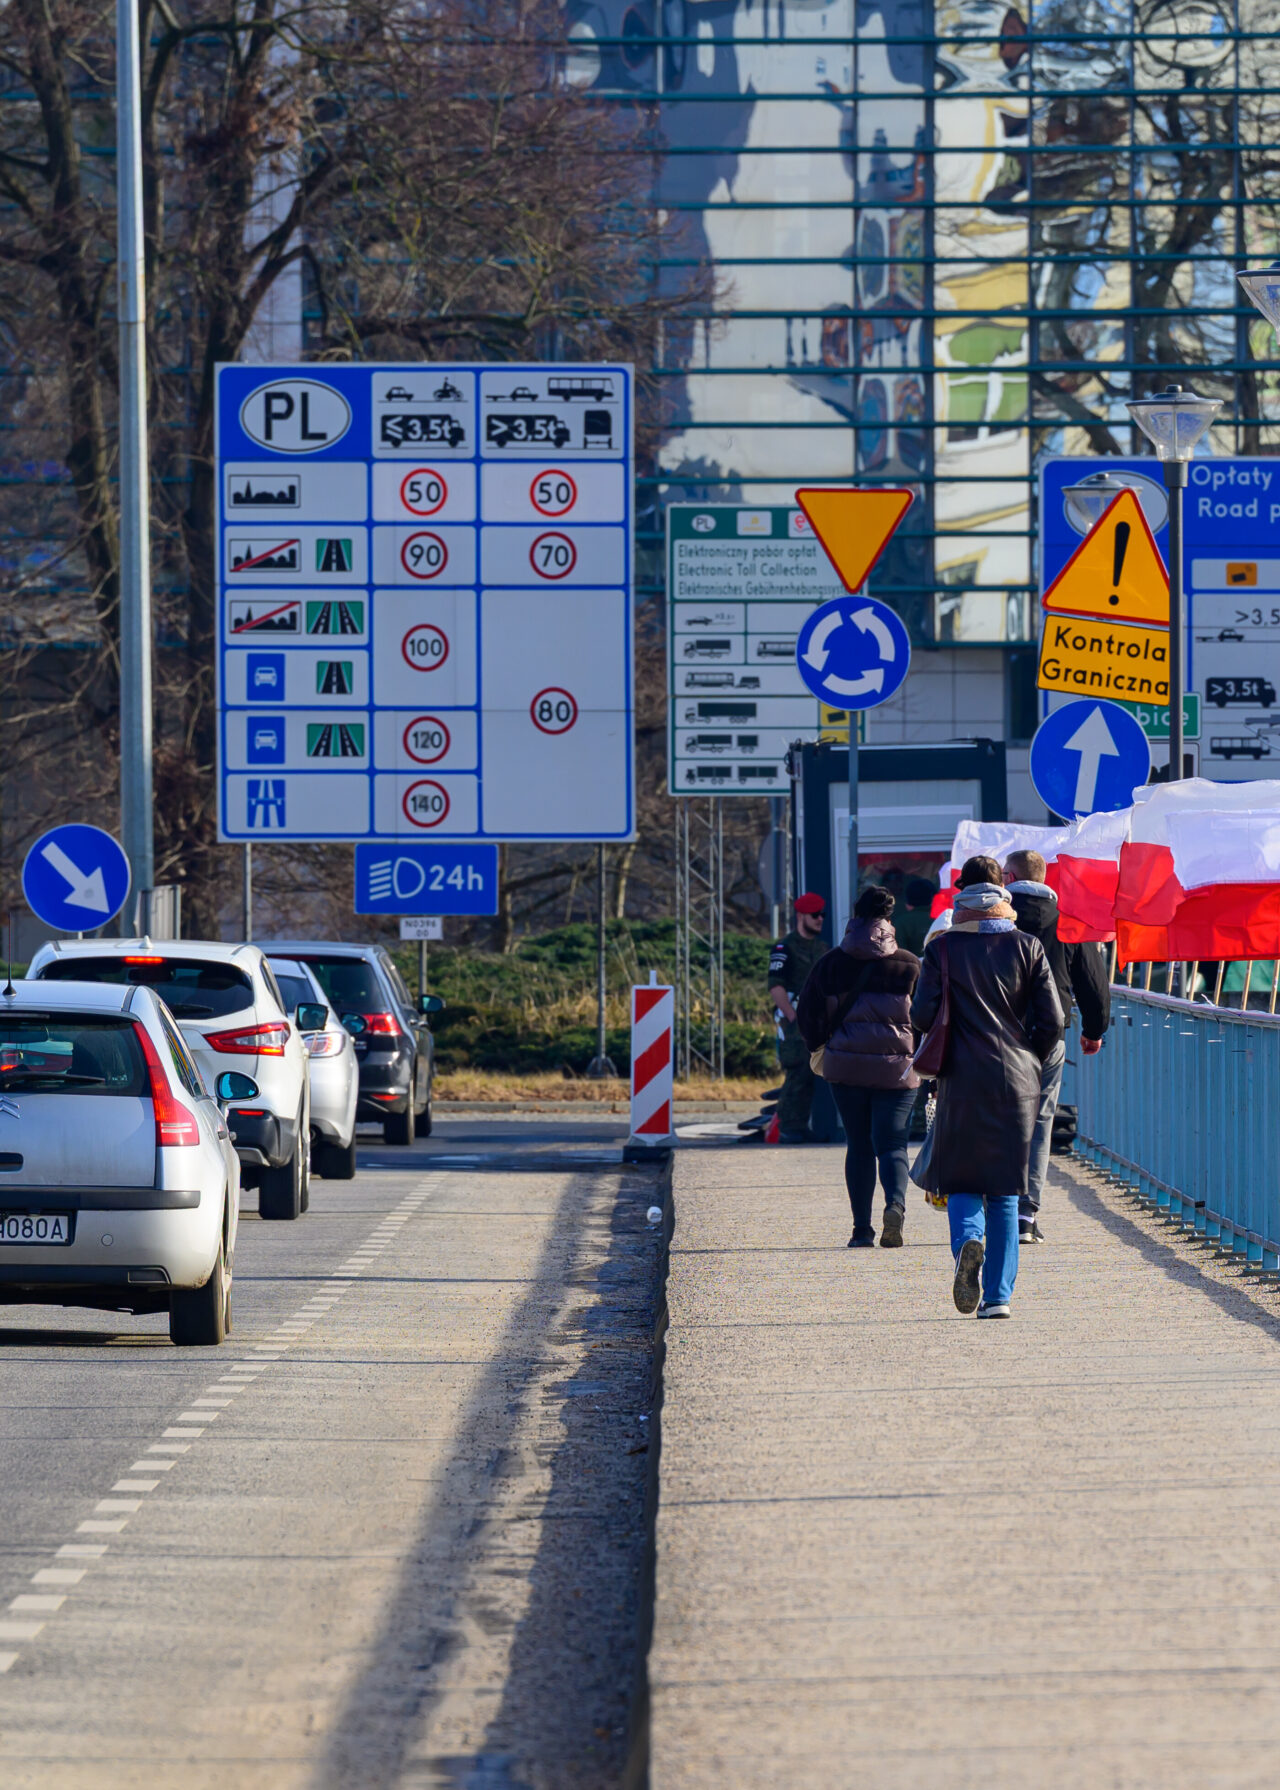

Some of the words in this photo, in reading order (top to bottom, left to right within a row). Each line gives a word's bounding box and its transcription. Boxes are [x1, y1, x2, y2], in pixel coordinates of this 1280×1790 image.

[264, 391, 328, 441] PL
[1191, 464, 1273, 492] Opłaty
[408, 480, 442, 504] 50
[537, 482, 571, 505] 50
[1198, 497, 1259, 518] Road
[695, 517, 711, 530] PL
[409, 544, 442, 567] 90
[540, 545, 570, 567] 70
[678, 563, 733, 577] Electronic
[737, 563, 756, 577] Toll
[760, 563, 817, 577] Collection
[409, 638, 443, 657] 100
[1054, 625, 1166, 662] Kontrola
[1042, 658, 1169, 696] Graniczna
[538, 700, 571, 722] 80
[412, 730, 443, 749] 120
[411, 794, 443, 813] 140
[429, 865, 483, 891] 24h
